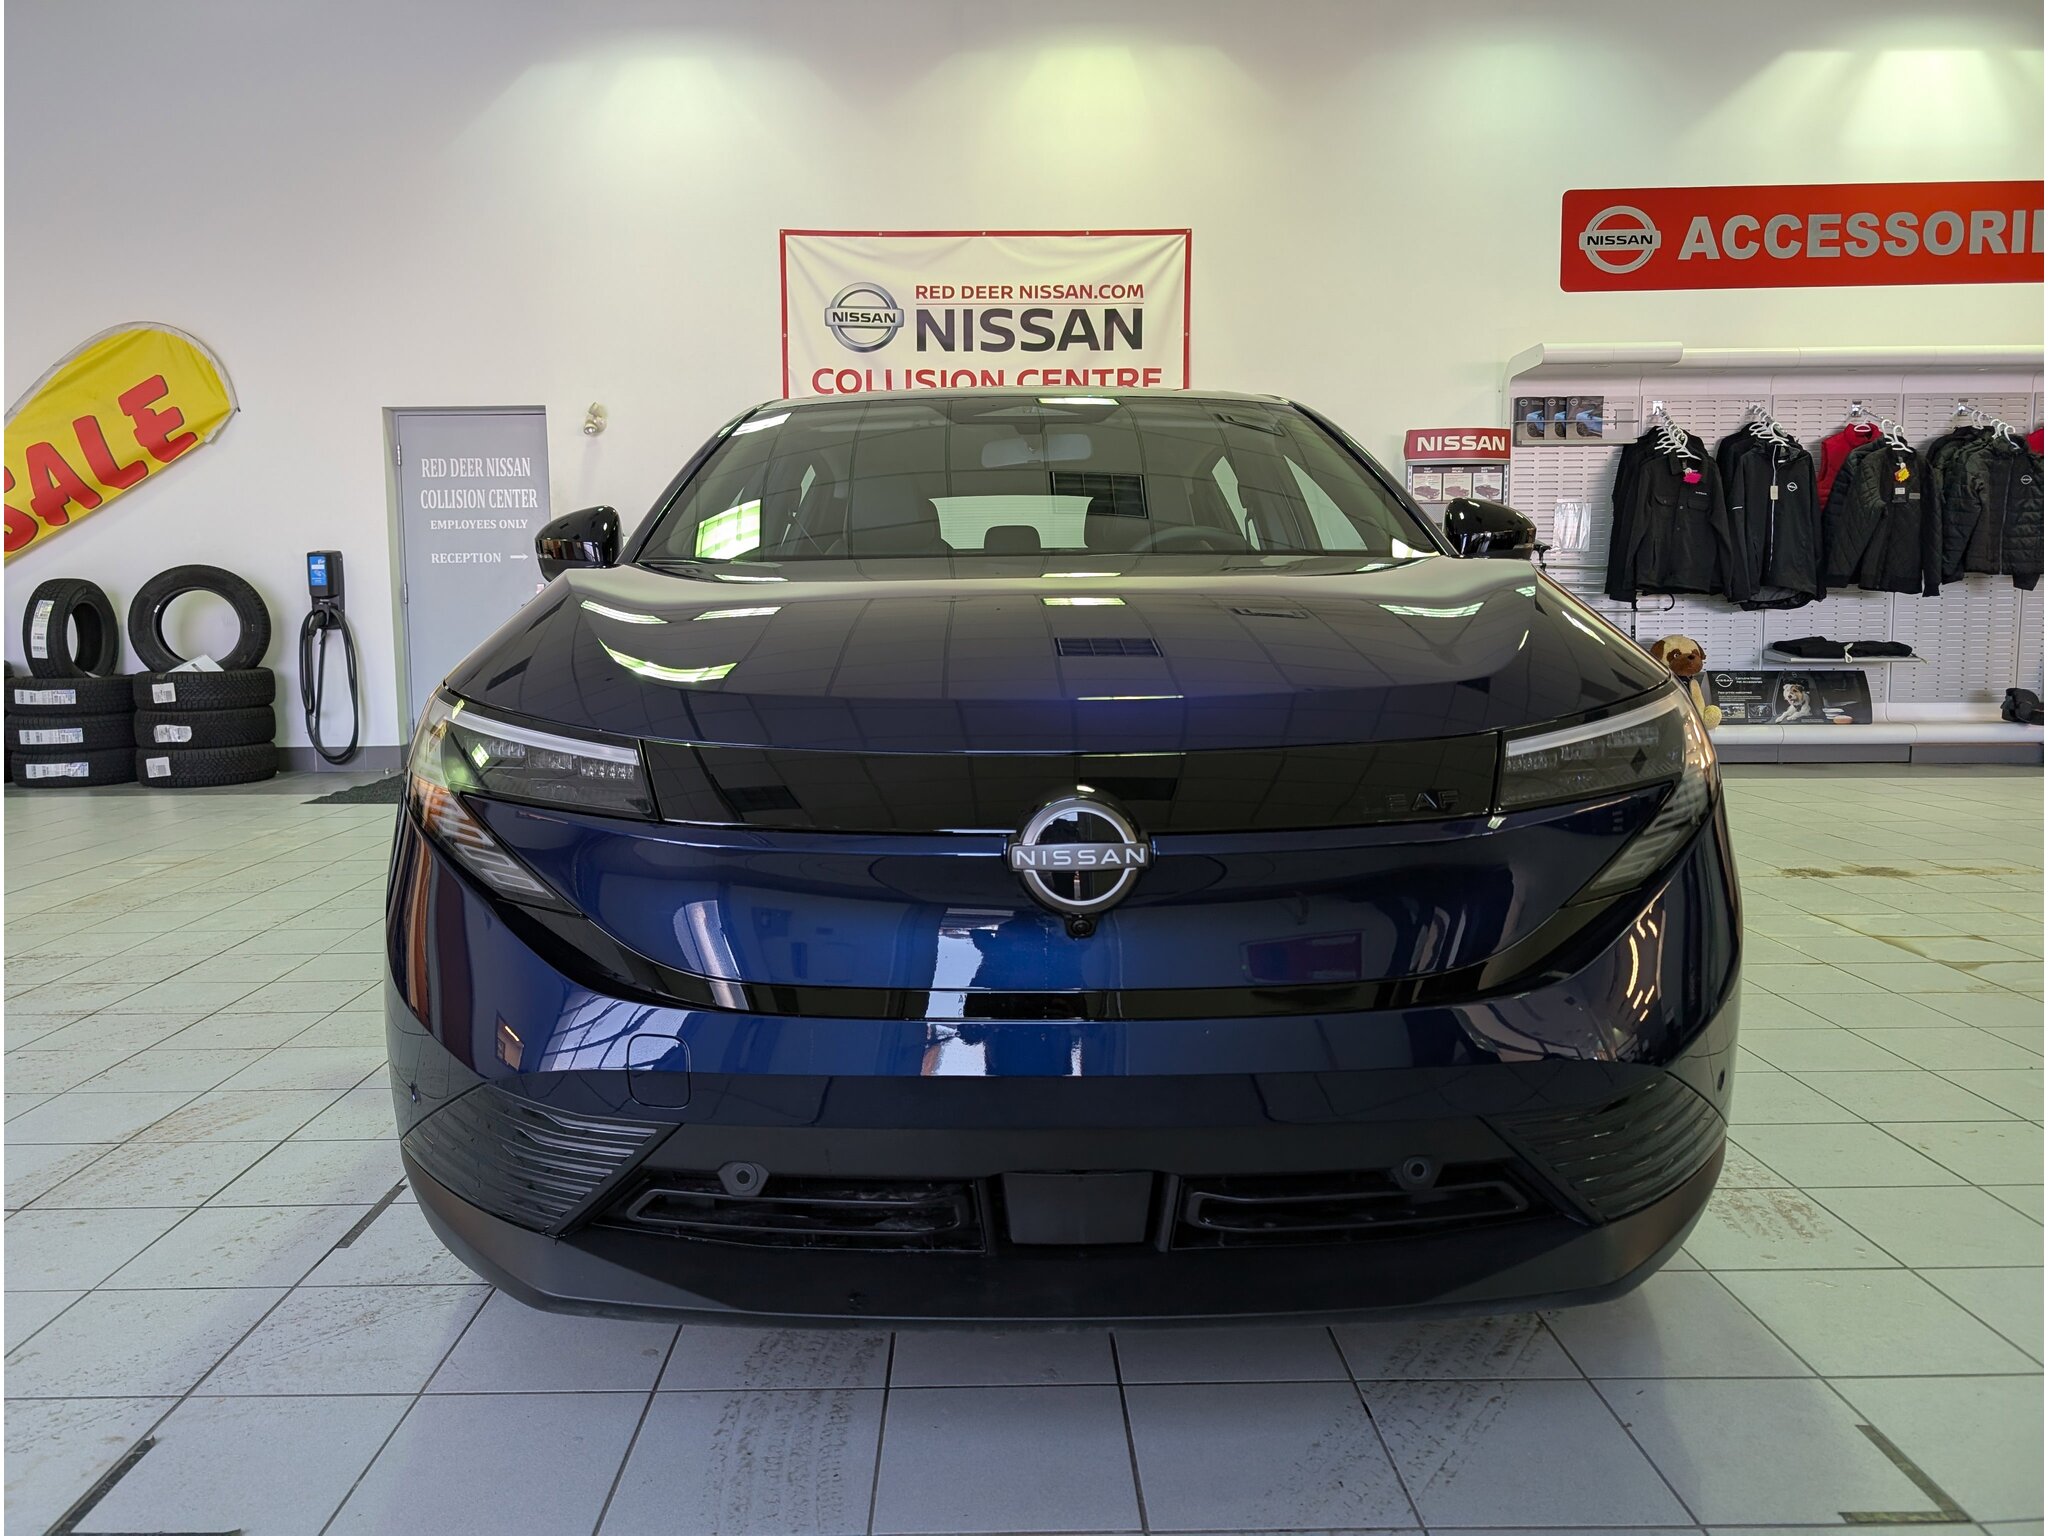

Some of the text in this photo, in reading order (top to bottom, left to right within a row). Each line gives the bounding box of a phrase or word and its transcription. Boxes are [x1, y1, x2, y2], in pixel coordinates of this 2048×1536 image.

[1587, 234, 1654, 246] NISSAN
[915, 284, 1144, 299] RED DEER NISSAN.COM
[832, 312, 896, 324] NISSAN
[916, 308, 1143, 352] NISSAN
[812, 368, 1162, 394] COLLISION CENTRE
[1417, 436, 1505, 451] NISSAN
[421, 457, 531, 478] RED DEER NISSAN
[420, 488, 538, 509] COLLISION CENTER
[430, 519, 528, 530] EMPLOYEES ONLY
[431, 552, 501, 564] RECEPTION
[1016, 848, 1145, 866] NISSAN
